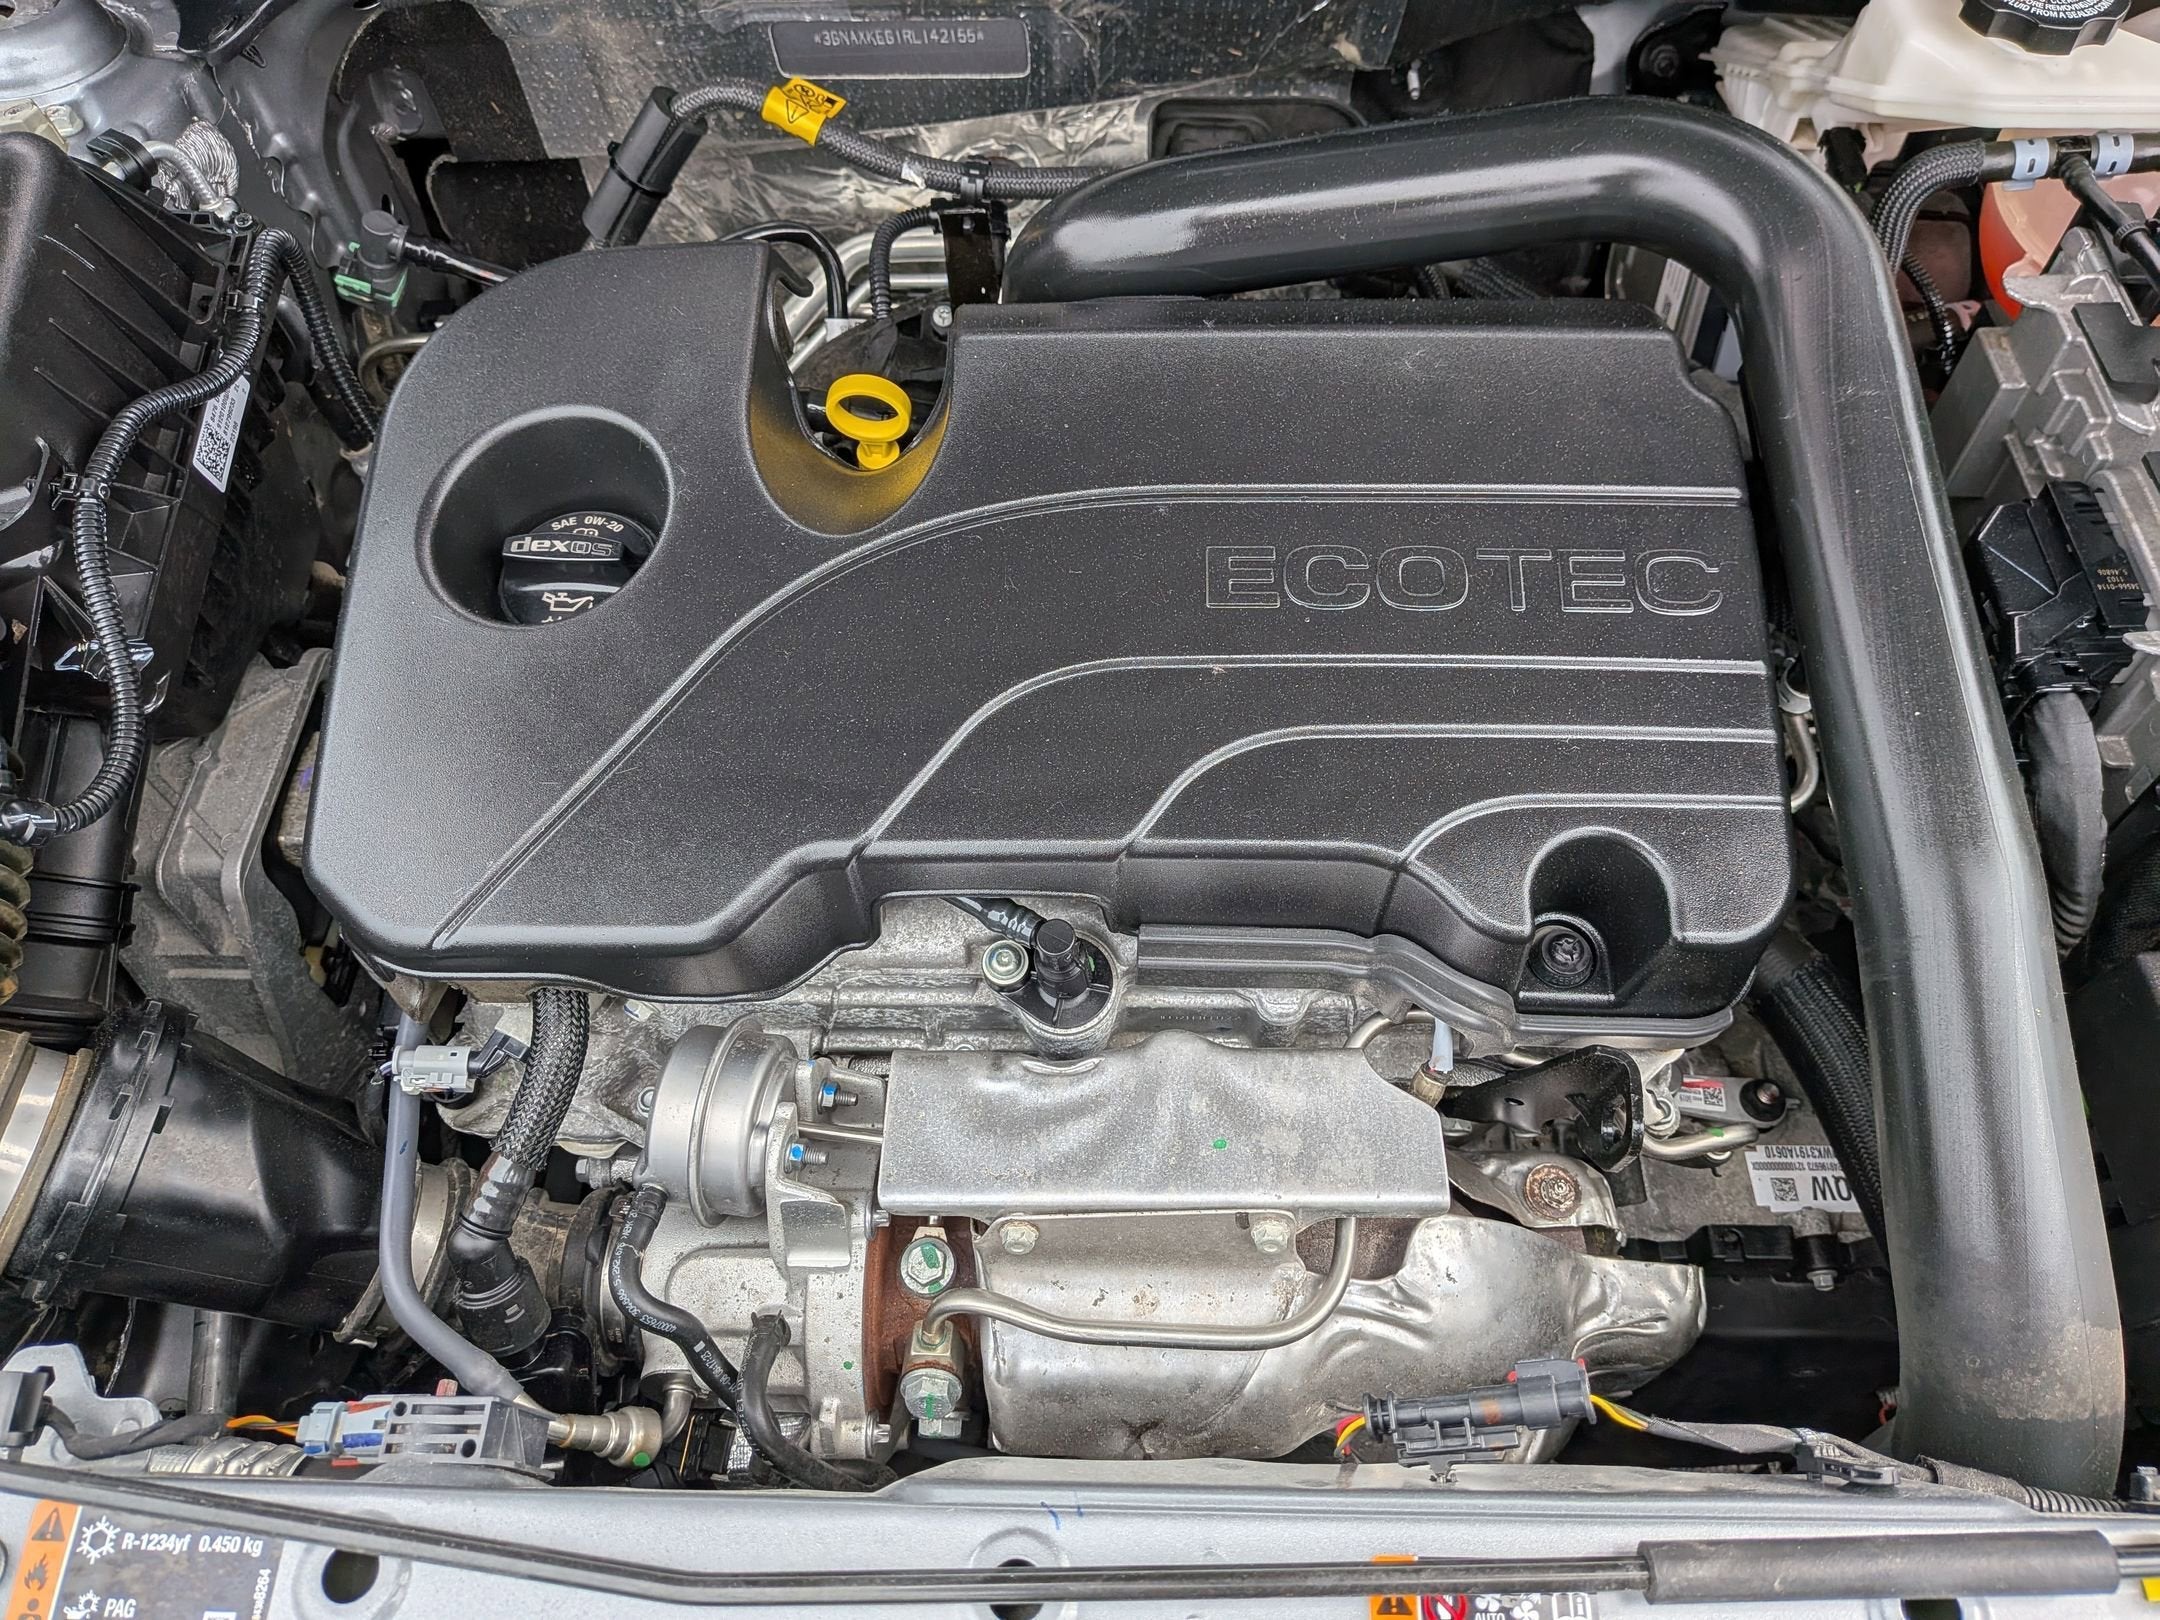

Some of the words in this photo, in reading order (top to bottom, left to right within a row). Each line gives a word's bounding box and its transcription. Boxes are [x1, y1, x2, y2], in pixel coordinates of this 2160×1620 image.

[2030, 7, 2058, 18] FROM
[2066, 8, 2099, 19] SEALED
[551, 516, 577, 531] SAE
[584, 515, 624, 533] 0W-20
[510, 536, 613, 557] dexos
[1205, 544, 1724, 617] ECOTEC
[121, 1532, 193, 1552] R-1234yf
[198, 1534, 241, 1553] 0.450
[242, 1536, 264, 1558] kg
[104, 1598, 137, 1618] PAG
